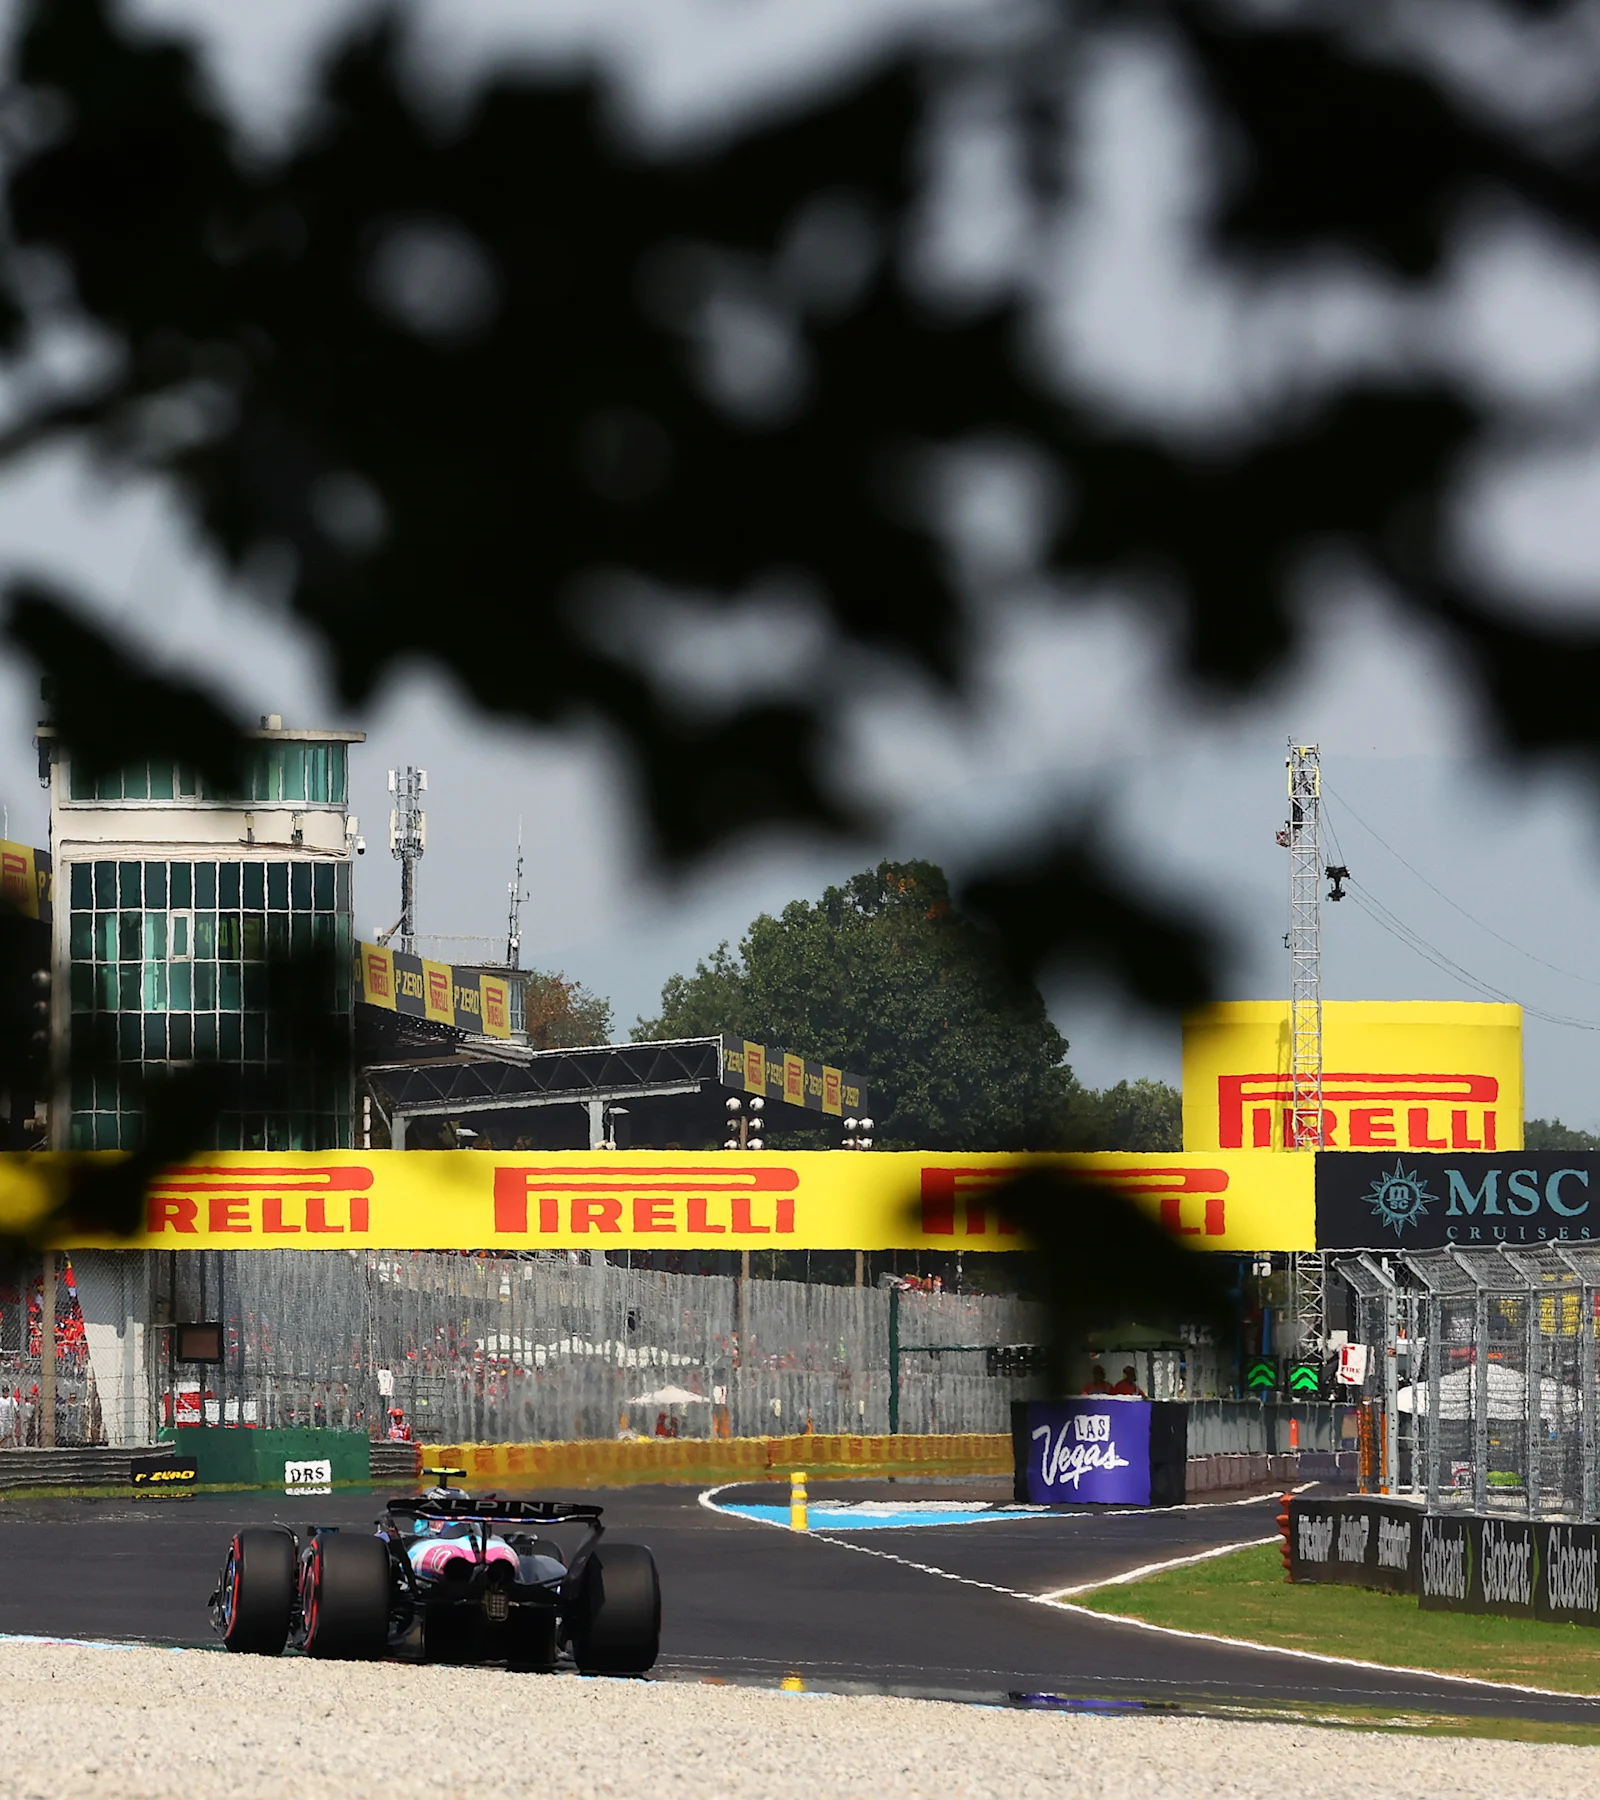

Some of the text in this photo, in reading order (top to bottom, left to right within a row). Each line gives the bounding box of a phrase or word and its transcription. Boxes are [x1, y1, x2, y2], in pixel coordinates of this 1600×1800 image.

[368, 954, 390, 997] PIRELLI
[395, 969, 423, 999] P ZERO
[428, 971, 449, 1013] PIRELLI
[454, 985, 479, 1015] P ZERO
[1218, 1073, 1499, 1151] PIRELLI
[494, 1167, 800, 1233] PIRELLI
[1444, 1168, 1590, 1217] MSC
[1446, 1226, 1591, 1240] CRUISES
[1341, 1366, 1361, 1374] FIRE
[1075, 1417, 1107, 1440] LAS
[290, 1466, 325, 1483] DRS
[1031, 1420, 1130, 1490] Vegas
[418, 1500, 576, 1514] ALPINE
[1421, 1517, 1466, 1599] Globant
[1481, 1520, 1531, 1605] Globant
[1546, 1526, 1599, 1613] Globant
